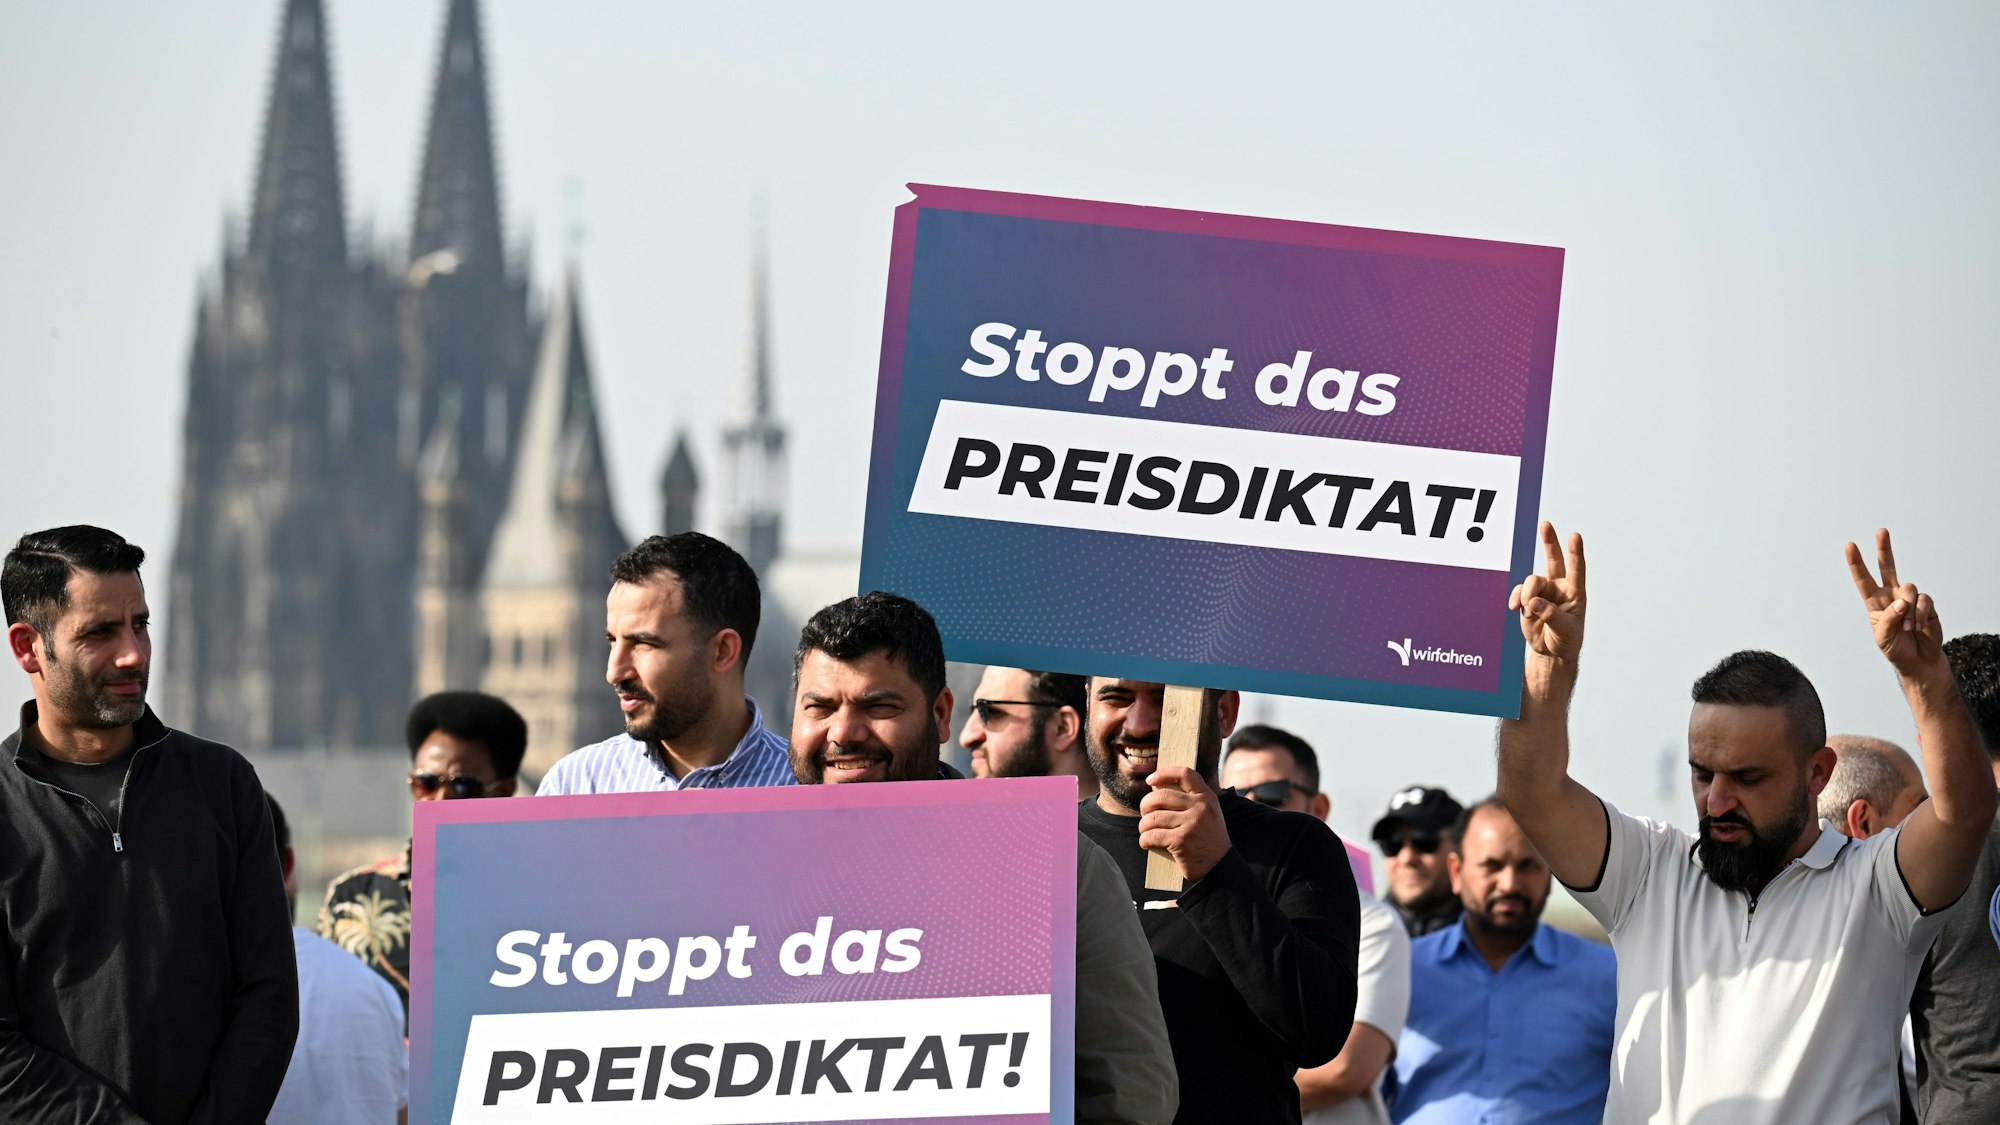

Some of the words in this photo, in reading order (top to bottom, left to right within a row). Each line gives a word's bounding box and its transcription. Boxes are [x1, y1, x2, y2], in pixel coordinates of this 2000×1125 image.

[960, 322, 1235, 407] Stoppt
[1254, 351, 1400, 416] das
[943, 437, 1498, 543] PREISDIKTAT!
[1412, 646, 1483, 667] wirfahren
[489, 925, 757, 997] Stoppt
[779, 916, 924, 977] das
[482, 1032, 1030, 1106] PREISDIKTAT!
